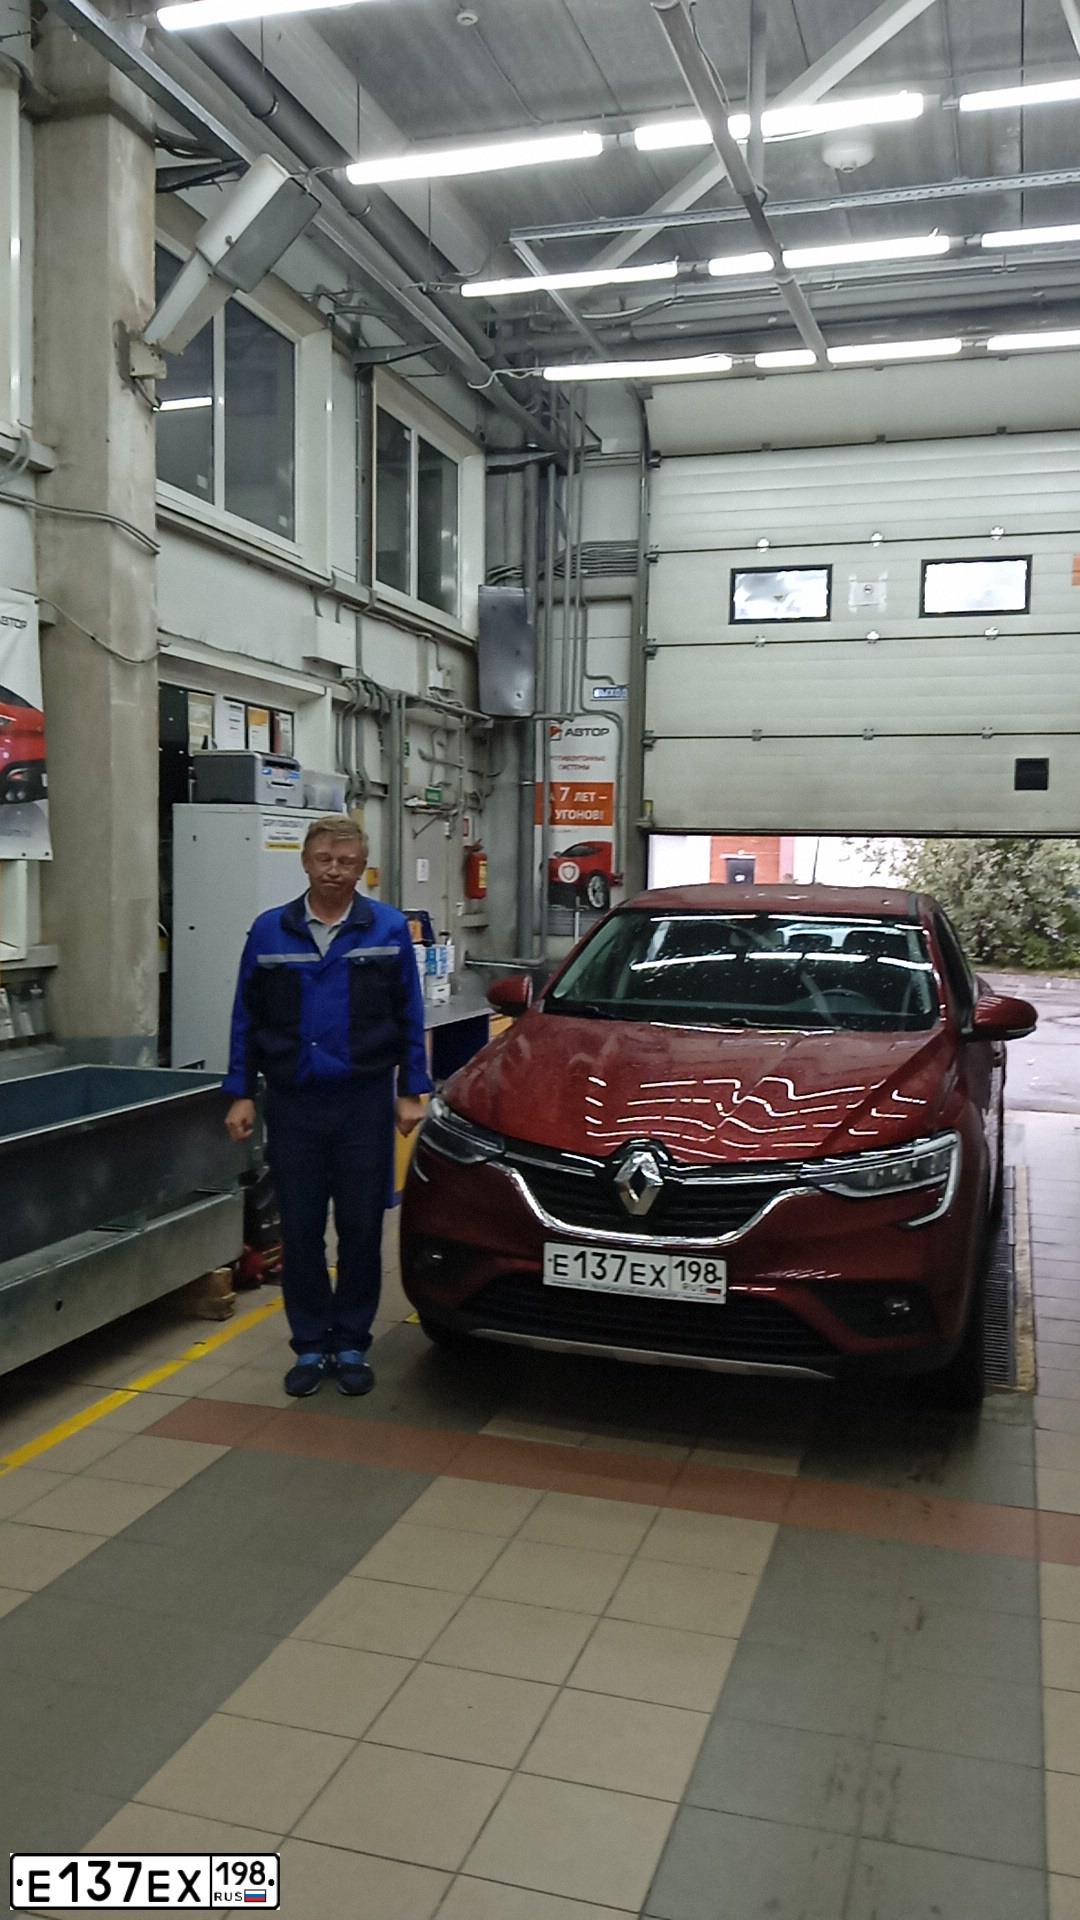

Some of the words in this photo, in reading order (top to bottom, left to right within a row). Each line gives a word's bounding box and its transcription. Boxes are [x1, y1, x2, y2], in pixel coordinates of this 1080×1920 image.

[559, 786, 571, 802] 7
[573, 791, 597, 802] ЛЕТ
[673, 1259, 718, 1285] 198
